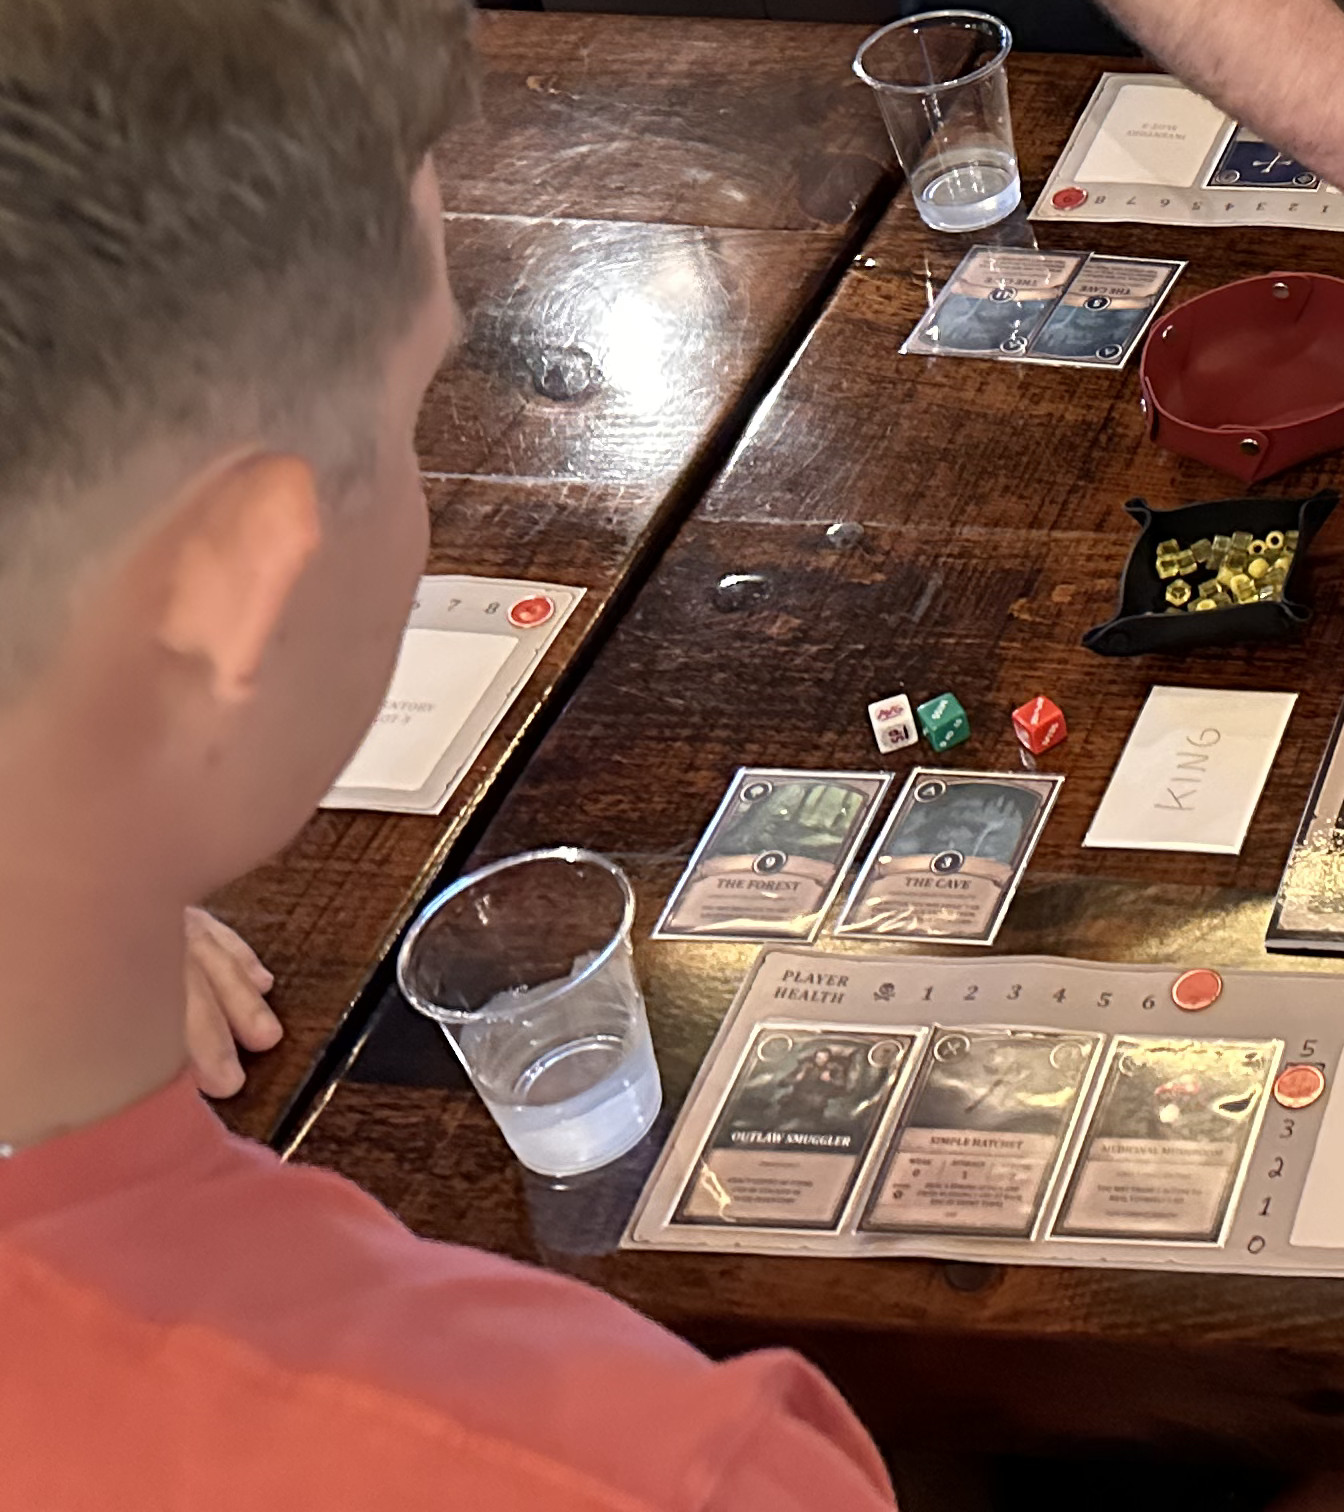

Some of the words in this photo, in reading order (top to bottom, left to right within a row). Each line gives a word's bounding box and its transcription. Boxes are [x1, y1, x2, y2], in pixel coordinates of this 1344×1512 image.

[1154, 726, 1221, 813] KING
[717, 878, 746, 889] THE
[747, 879, 801, 890] FOREST
[905, 877, 936, 888] THE
[937, 878, 972, 890] CAVE
[783, 968, 848, 988] PLAYER
[774, 986, 845, 1005] HEALTH
[922, 987, 934, 1001] 1
[964, 986, 979, 1001] 2
[1007, 984, 1022, 1001] 3
[1052, 988, 1066, 1004] 4
[1097, 991, 1112, 1008] 5
[1142, 994, 1155, 1010] 6
[1301, 1039, 1318, 1057] 5
[1279, 1119, 1295, 1139] 3
[731, 1131, 785, 1144] OUTLAW
[785, 1132, 851, 1147] SMUGGLER
[930, 1136, 969, 1147] SIMPLE
[971, 1138, 1024, 1149] HATCHET
[1267, 1156, 1284, 1178] 2
[1259, 1196, 1272, 1218] 1
